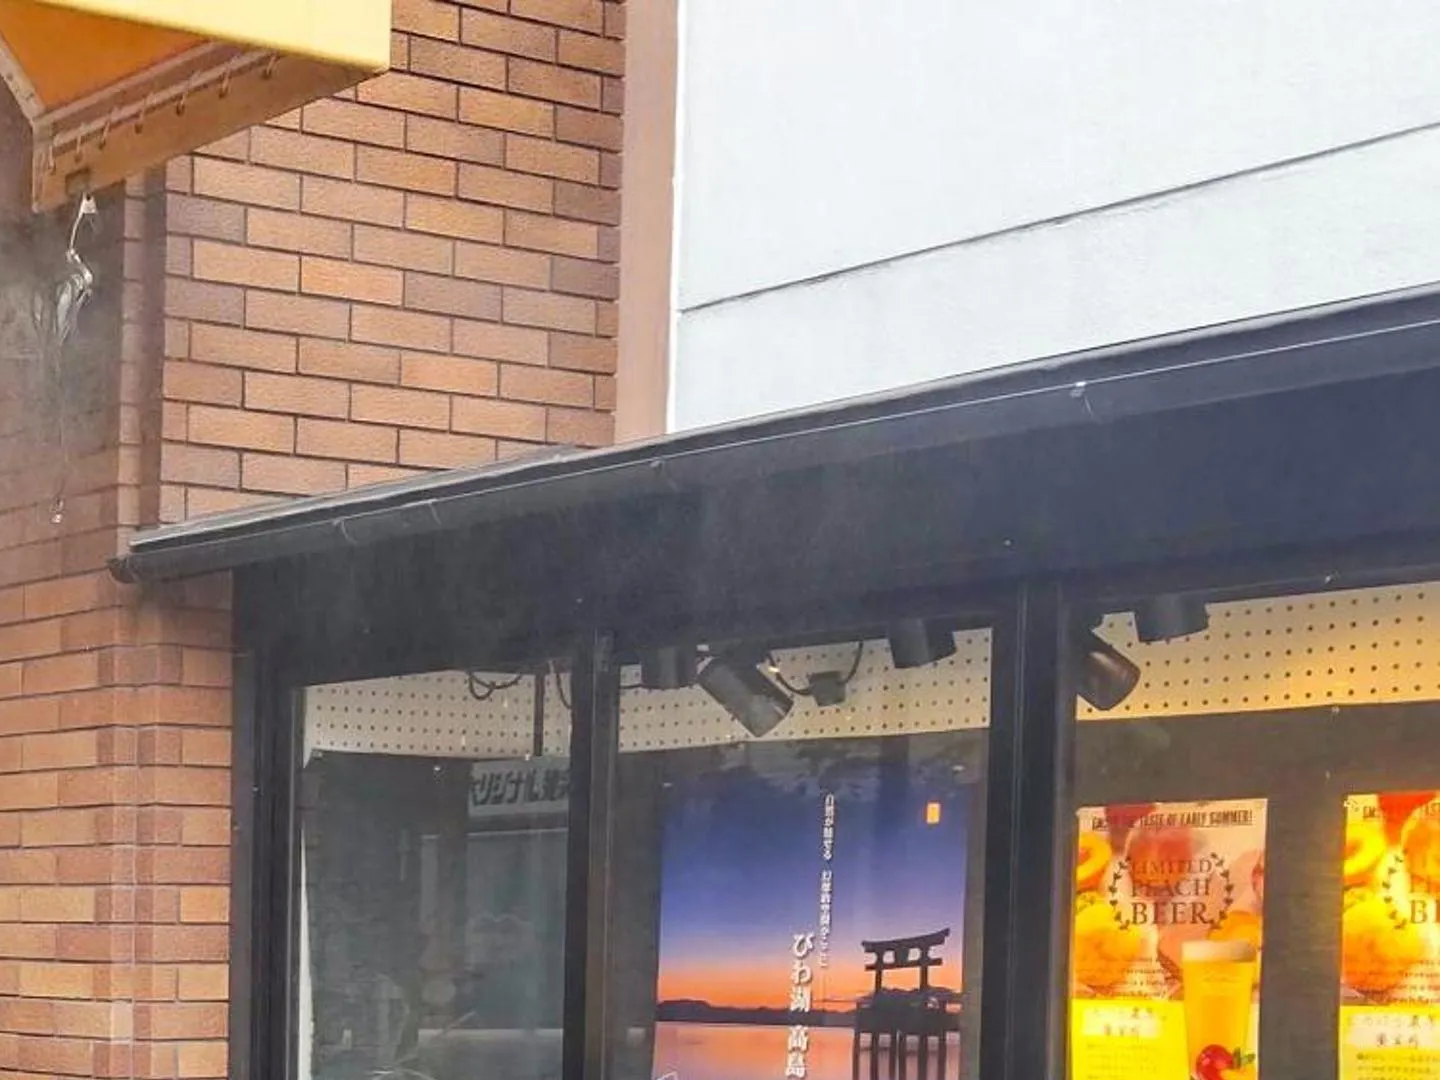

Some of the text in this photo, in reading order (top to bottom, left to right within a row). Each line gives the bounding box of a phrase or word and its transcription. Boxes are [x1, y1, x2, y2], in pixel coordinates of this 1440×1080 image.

[1131, 877, 1211, 898] PEACH
[1131, 901, 1212, 925] BEER
[789, 932, 815, 1013] びわ湖
